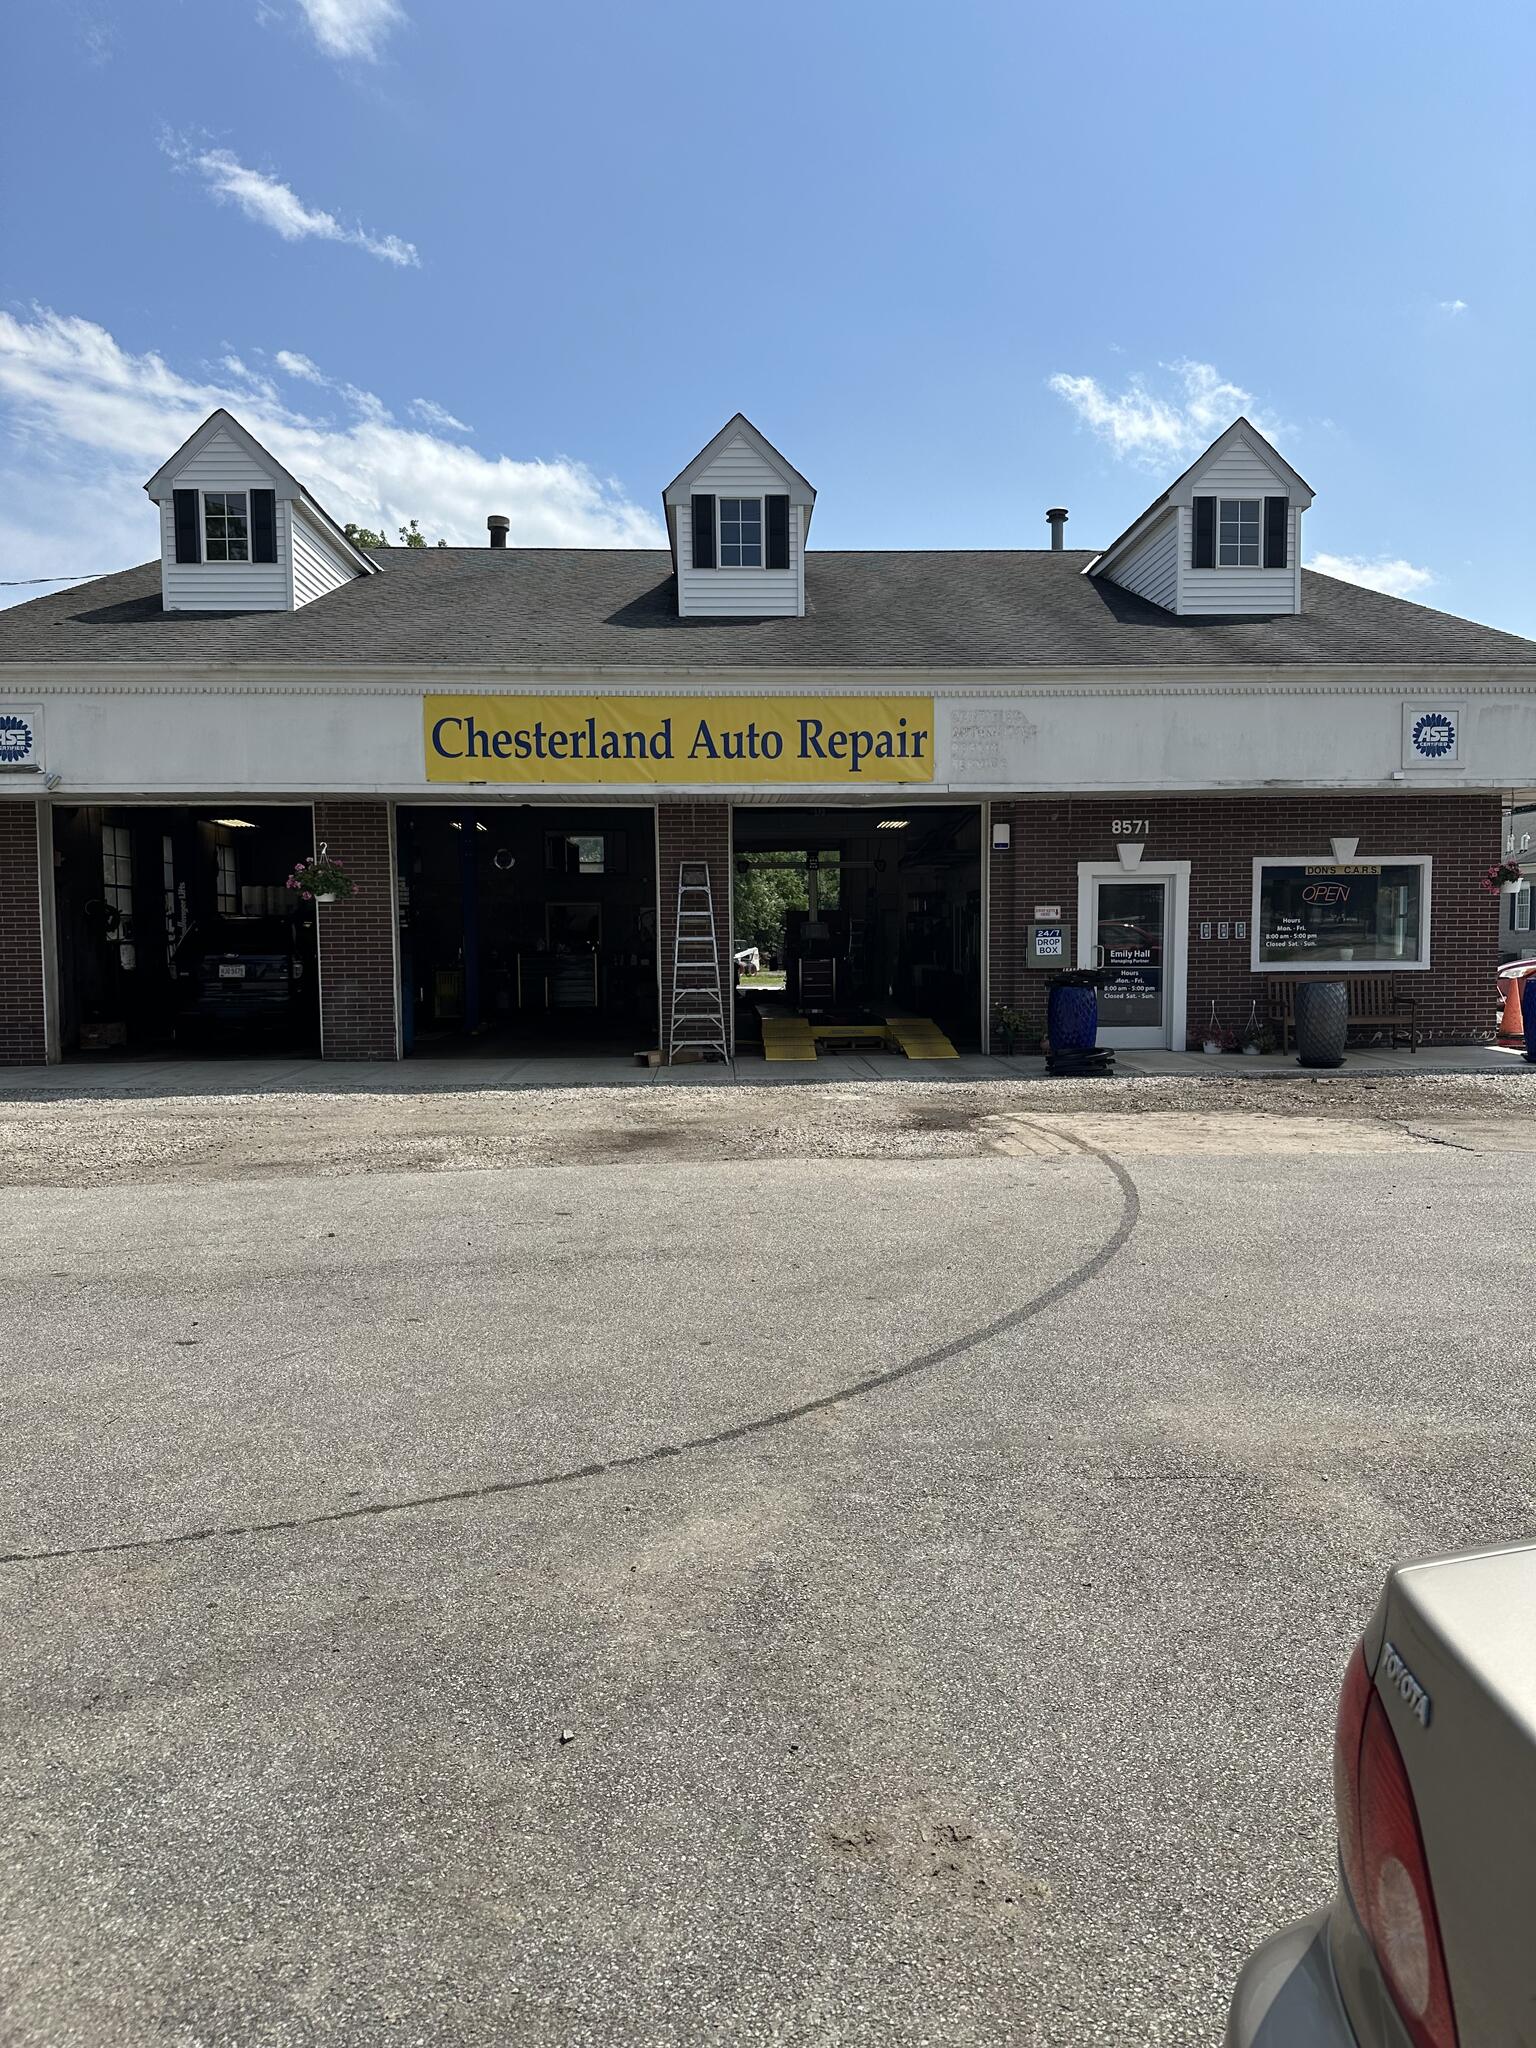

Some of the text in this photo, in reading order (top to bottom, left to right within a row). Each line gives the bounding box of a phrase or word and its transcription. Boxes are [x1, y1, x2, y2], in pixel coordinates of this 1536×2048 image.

[1418, 726, 1448, 741] ASE
[432, 716, 928, 772] Chesterland Auto Repair
[1111, 819, 1150, 834] 8571
[1302, 886, 1351, 901] OPEN
[1037, 938, 1060, 946] DROP
[1039, 946, 1059, 954] BOX
[1110, 950, 1151, 959] Emily Hall
[1381, 1641, 1431, 1727] TOYOTA
